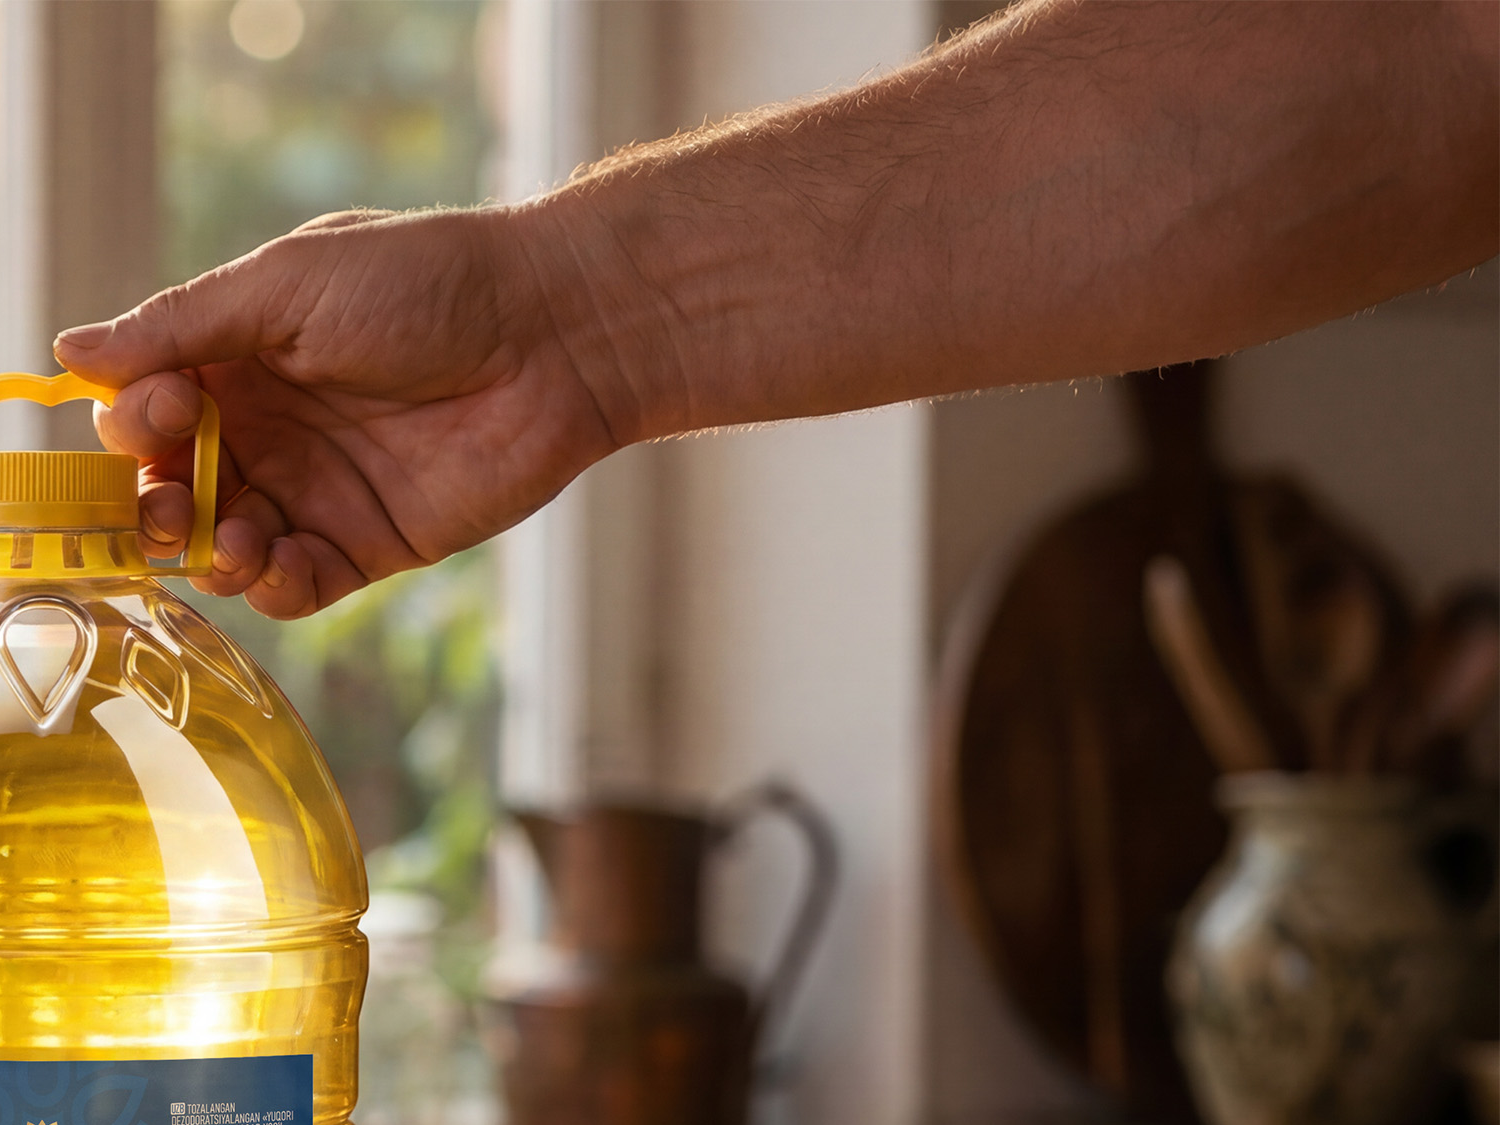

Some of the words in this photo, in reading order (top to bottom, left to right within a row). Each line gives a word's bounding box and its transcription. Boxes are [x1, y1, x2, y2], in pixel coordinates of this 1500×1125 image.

[172, 1104, 184, 1114] UZB
[187, 1103, 235, 1114] TOZALANGAN
[172, 1112, 260, 1125] DEZODORATSIYALANGAN
[263, 1111, 294, 1122] «YUQORI
